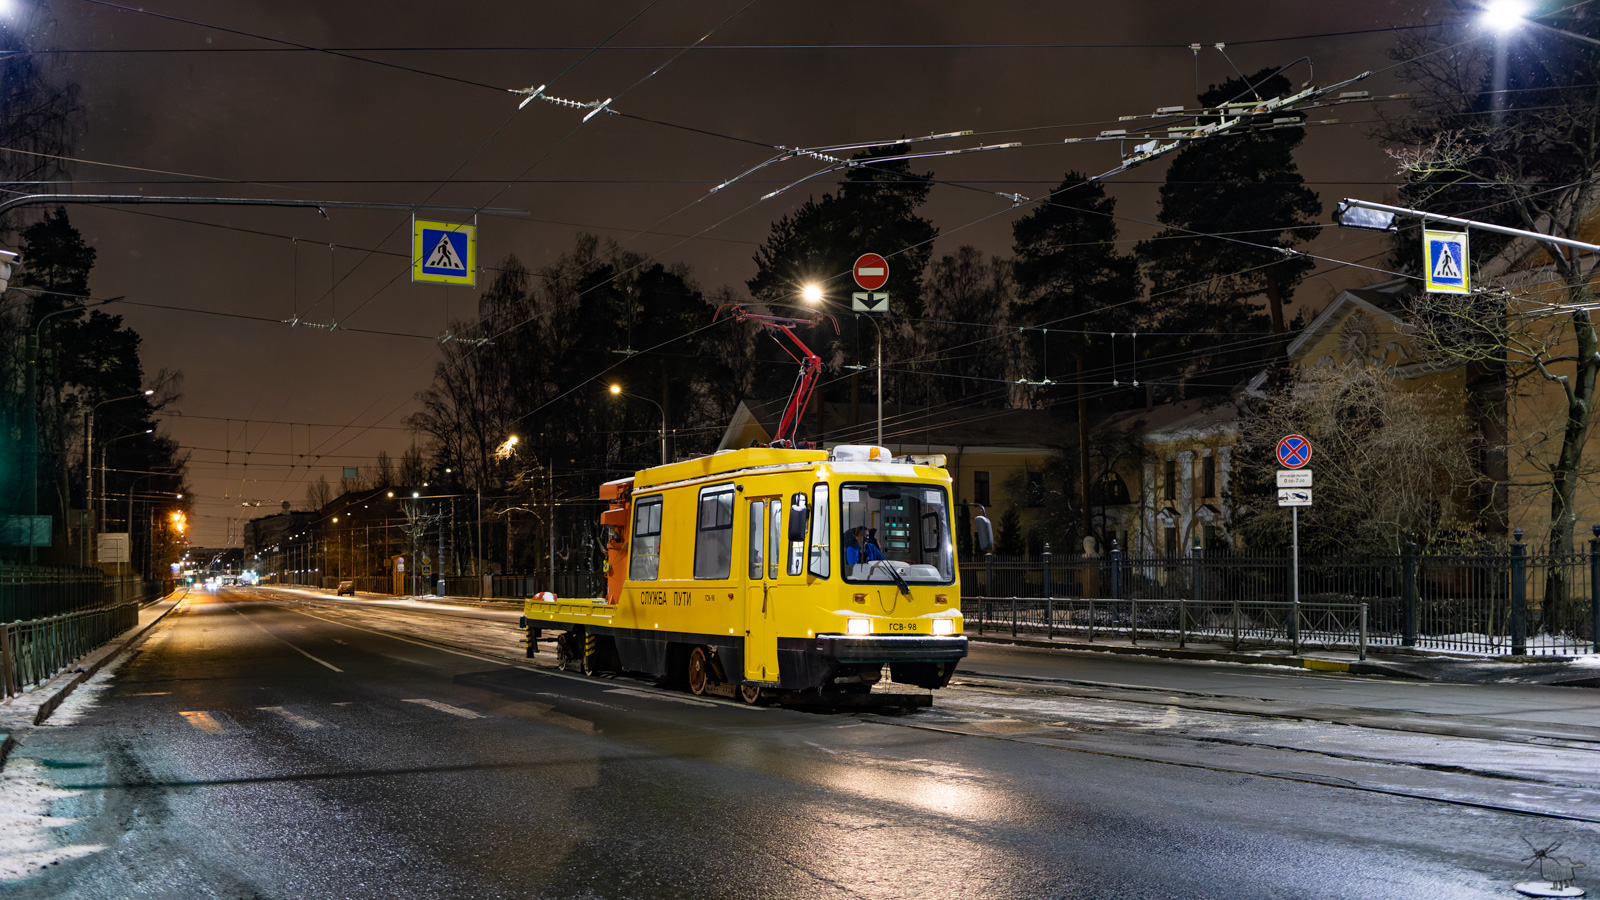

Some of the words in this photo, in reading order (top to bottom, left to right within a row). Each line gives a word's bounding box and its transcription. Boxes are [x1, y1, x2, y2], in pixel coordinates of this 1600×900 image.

[640, 591, 667, 605] СЛУЖБА
[673, 591, 692, 606] ПУТИ
[889, 623, 917, 631] ГСВ-98
